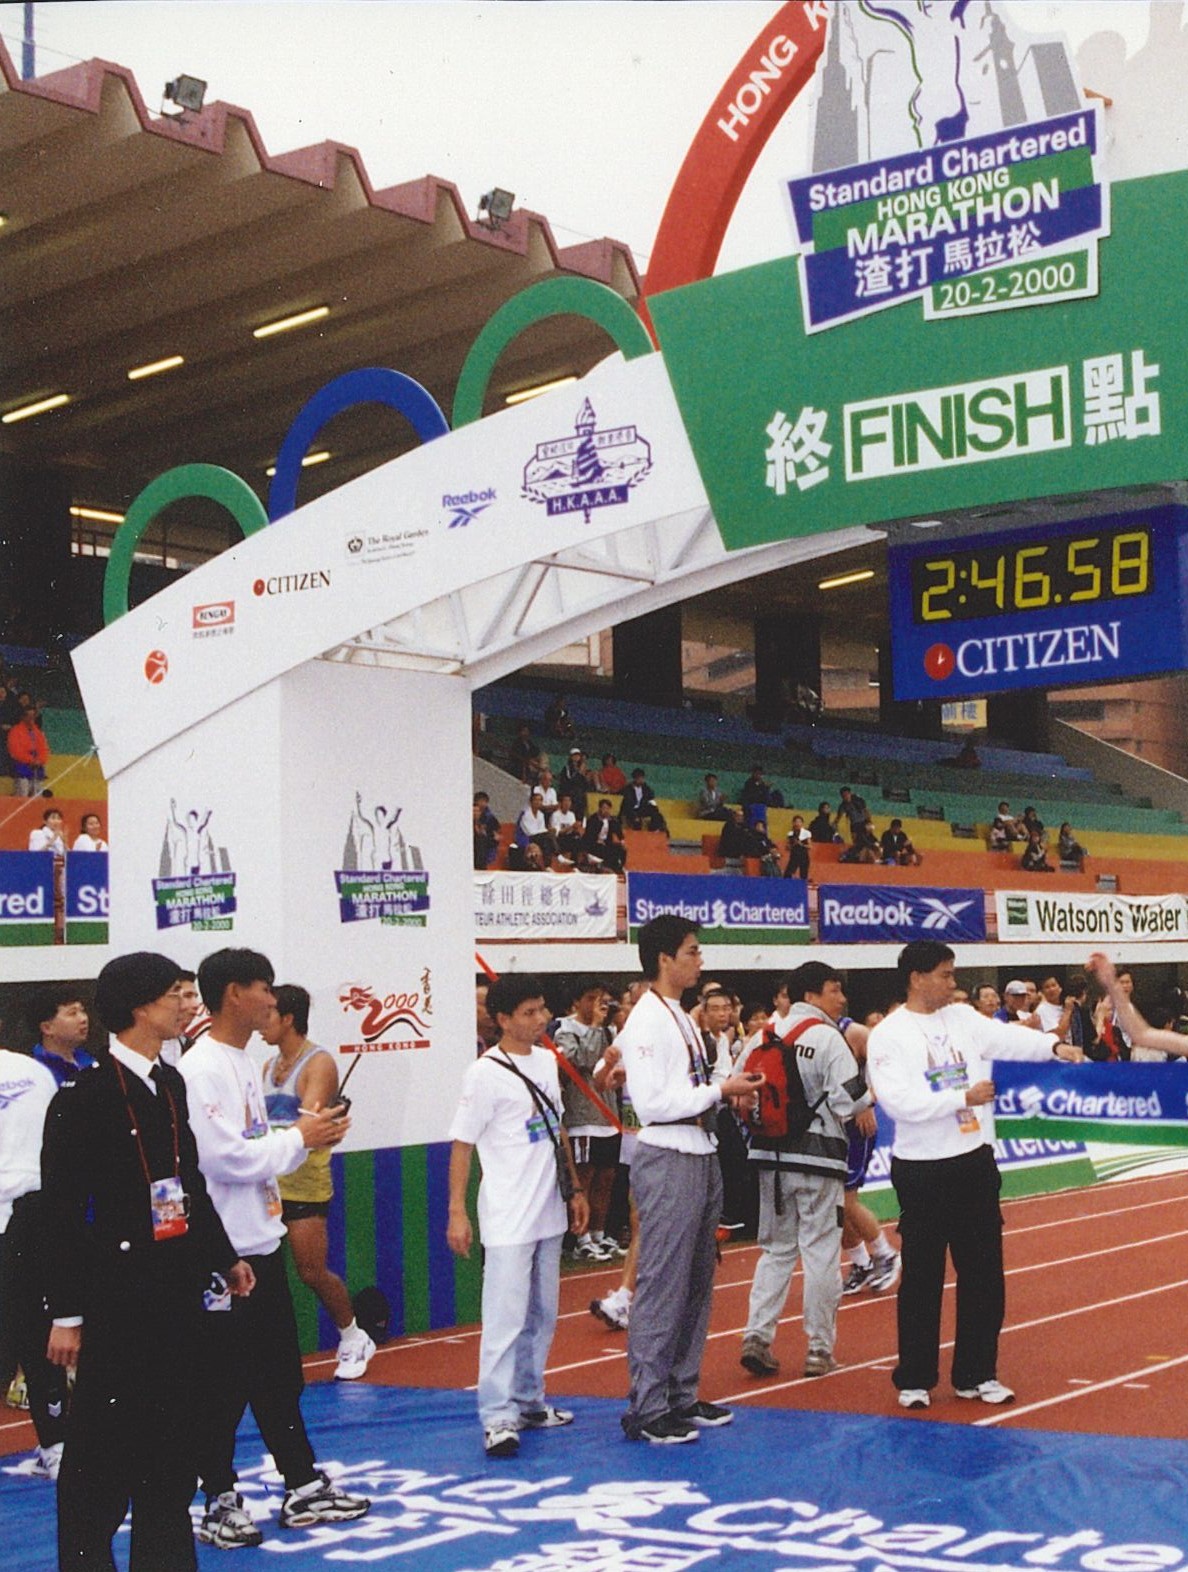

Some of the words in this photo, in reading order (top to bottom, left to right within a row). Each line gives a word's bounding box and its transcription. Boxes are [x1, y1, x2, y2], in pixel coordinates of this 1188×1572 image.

[717, 35, 798, 141] HONG
[809, 149, 934, 211] Standard
[941, 118, 1087, 178] Chartered
[877, 186, 942, 220] HONG
[947, 168, 1009, 203] KONG
[847, 179, 1059, 257] MARATHON
[855, 246, 933, 298] 渣打
[943, 222, 1041, 273] 馬拉松
[940, 262, 1075, 309] 20-2-2000
[765, 405, 833, 495] 終
[851, 374, 1064, 475] FINISH
[1083, 350, 1161, 446] 點
[442, 488, 497, 507] Reebok
[267, 569, 331, 595] CITIZEN
[921, 531, 1149, 621] 2:46.58
[956, 622, 1121, 677] CITIZEN
[165, 892, 226, 909] MARATHON
[351, 890, 418, 904] MARATHON
[635, 898, 709, 921] Standard
[730, 902, 805, 924] Chartered
[823, 898, 914, 927] Reebok
[496, 912, 530, 926] ATHLETIC
[532, 912, 578, 926] ASSOCIATION
[1035, 900, 1124, 933] Watson's
[1130, 903, 1181, 932] Water
[354, 1043, 382, 1052] HONG
[388, 1042, 416, 1050] KONG
[1046, 1088, 1161, 1118] Chartered
